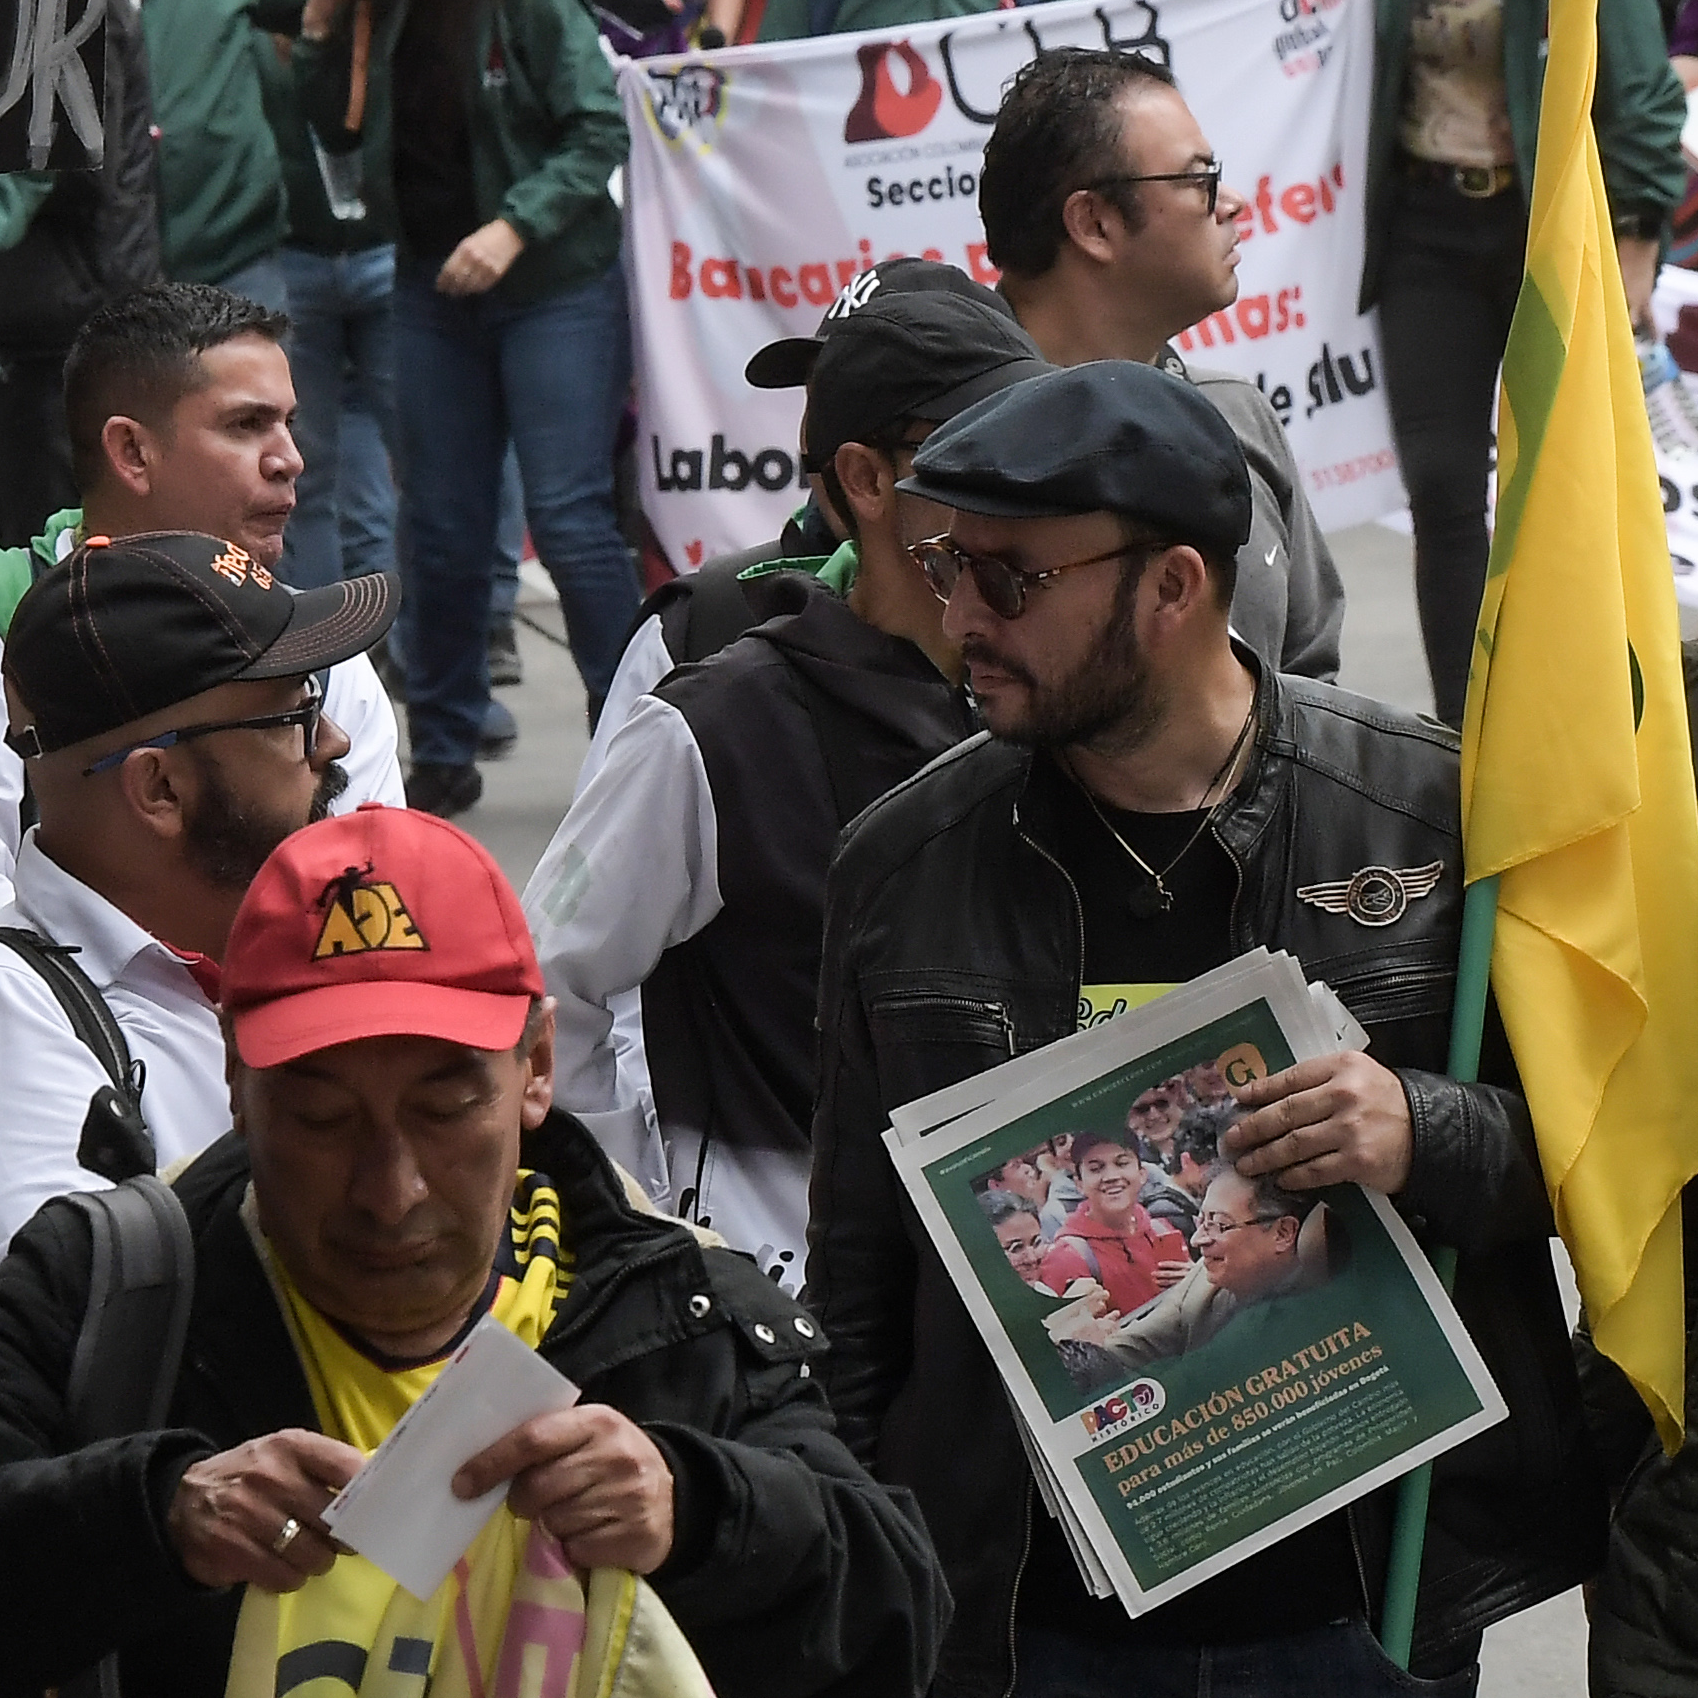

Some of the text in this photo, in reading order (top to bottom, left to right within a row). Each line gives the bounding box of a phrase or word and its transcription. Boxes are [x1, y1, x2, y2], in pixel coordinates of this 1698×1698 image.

[868, 165, 976, 209] Seccio
[652, 433, 812, 492] Labo
[312, 881, 431, 962] ADE
[1224, 1057, 1258, 1087] G
[1083, 1384, 1154, 1434] PACTO
[1092, 1403, 1158, 1441] HISTÓRICO
[1102, 1322, 1370, 1472] EDUCACIÓN GRATUITA
[1118, 1346, 1381, 1495] para más de 850.000 jóvenes
